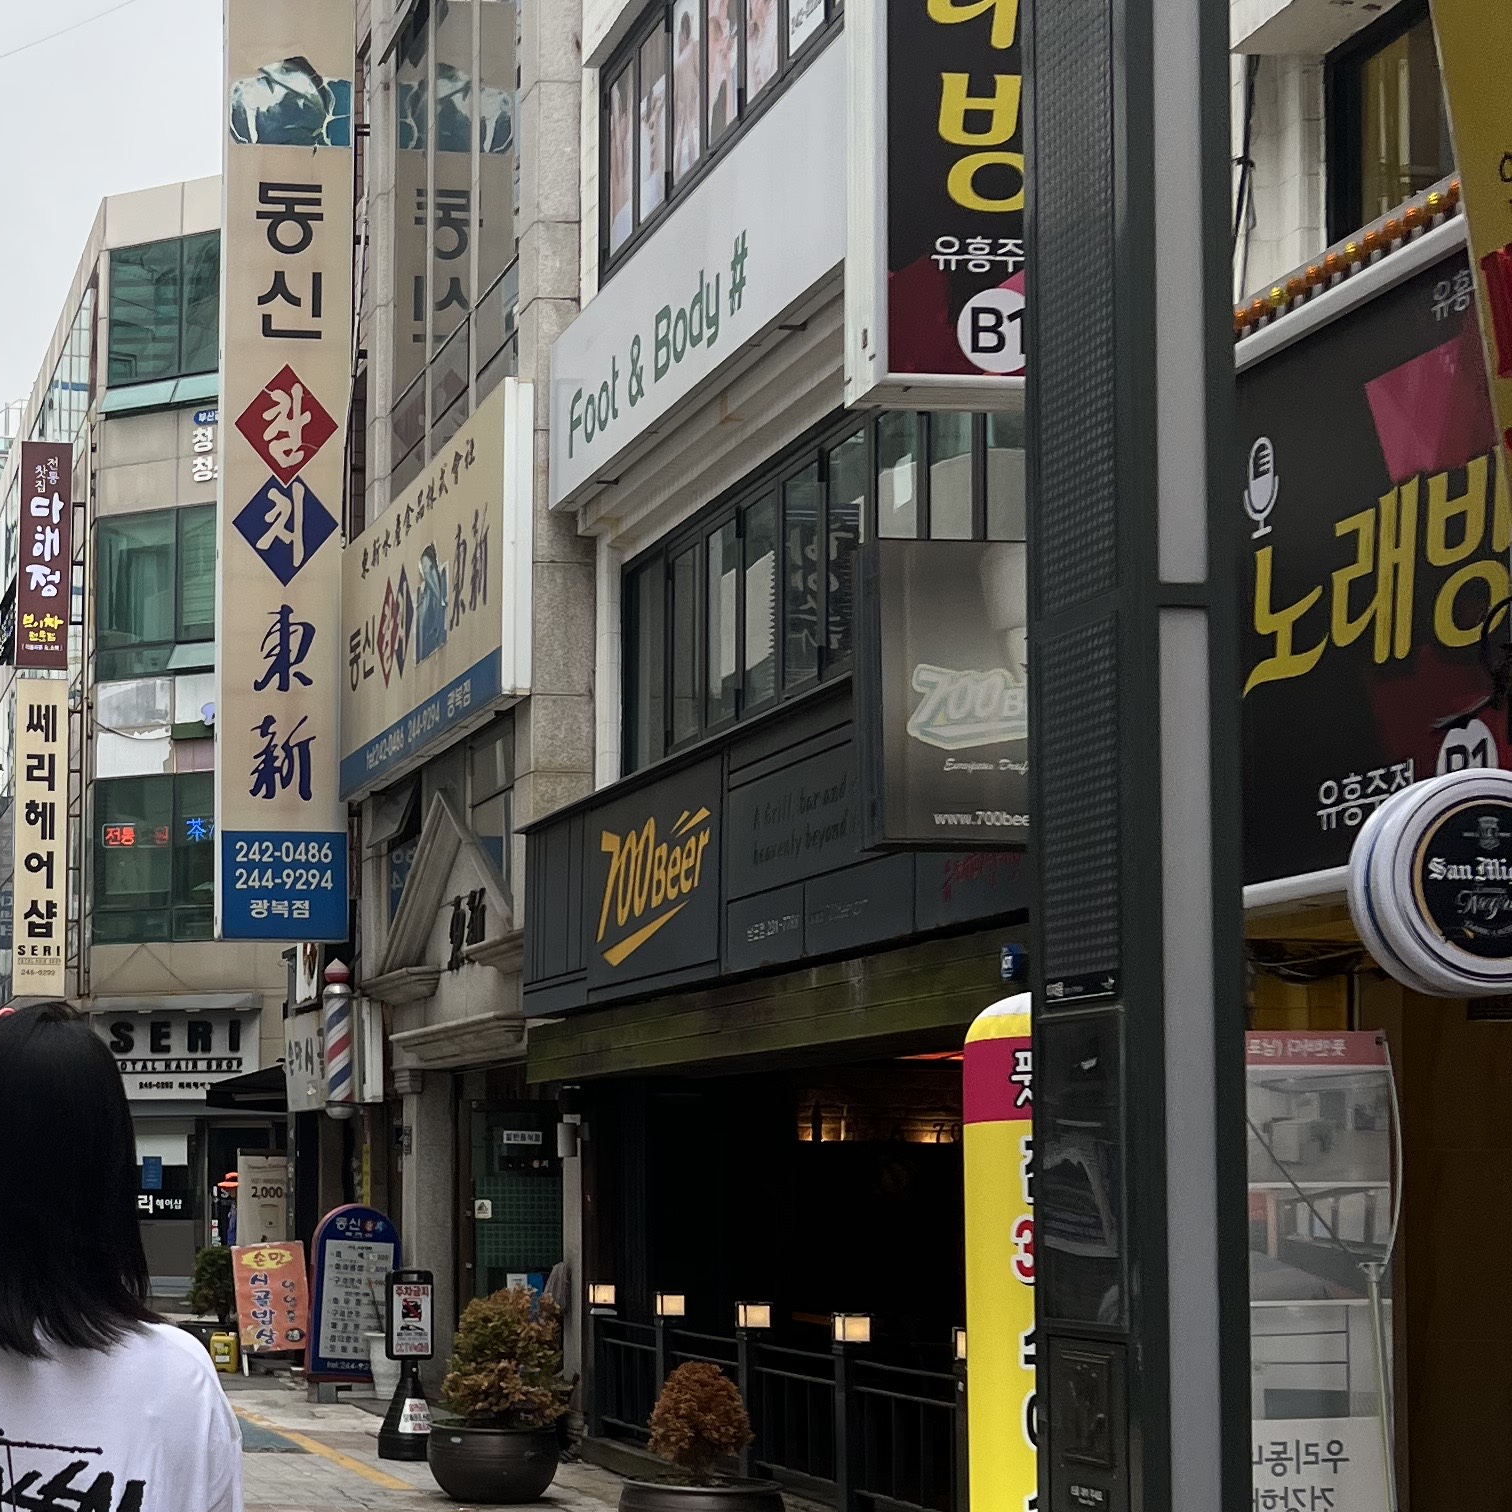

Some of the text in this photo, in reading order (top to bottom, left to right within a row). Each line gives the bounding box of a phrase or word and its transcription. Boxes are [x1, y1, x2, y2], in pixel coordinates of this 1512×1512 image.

[926, 0, 1024, 212] 방
[256, 181, 323, 340] 동신
[931, 237, 1025, 273] 유흥주
[1431, 270, 1475, 321] 유흥
[569, 354, 618, 460] Foot
[629, 335, 644, 408] &
[654, 269, 720, 384] Body
[199, 410, 218, 422] 부산
[47, 457, 60, 485] 전통
[26, 492, 65, 597] 다해정
[349, 615, 376, 692] 동신
[249, 604, 316, 802] 東新
[915, 667, 1027, 722] 700B
[25, 704, 58, 938] 쎄리헤어샵
[933, 811, 1030, 826] www.700bee
[235, 842, 332, 865] 242-0486
[1428, 857, 1472, 880] San
[235, 868, 332, 892] 244-9294
[250, 900, 310, 918] 광복점
[18, 945, 61, 956] SERI
[110, 1020, 240, 1053] SERI
[120, 1060, 242, 1071] OYAL HAIR SHOP
[335, 1217, 361, 1231] 동신
[253, 1251, 285, 1267] 손맛
